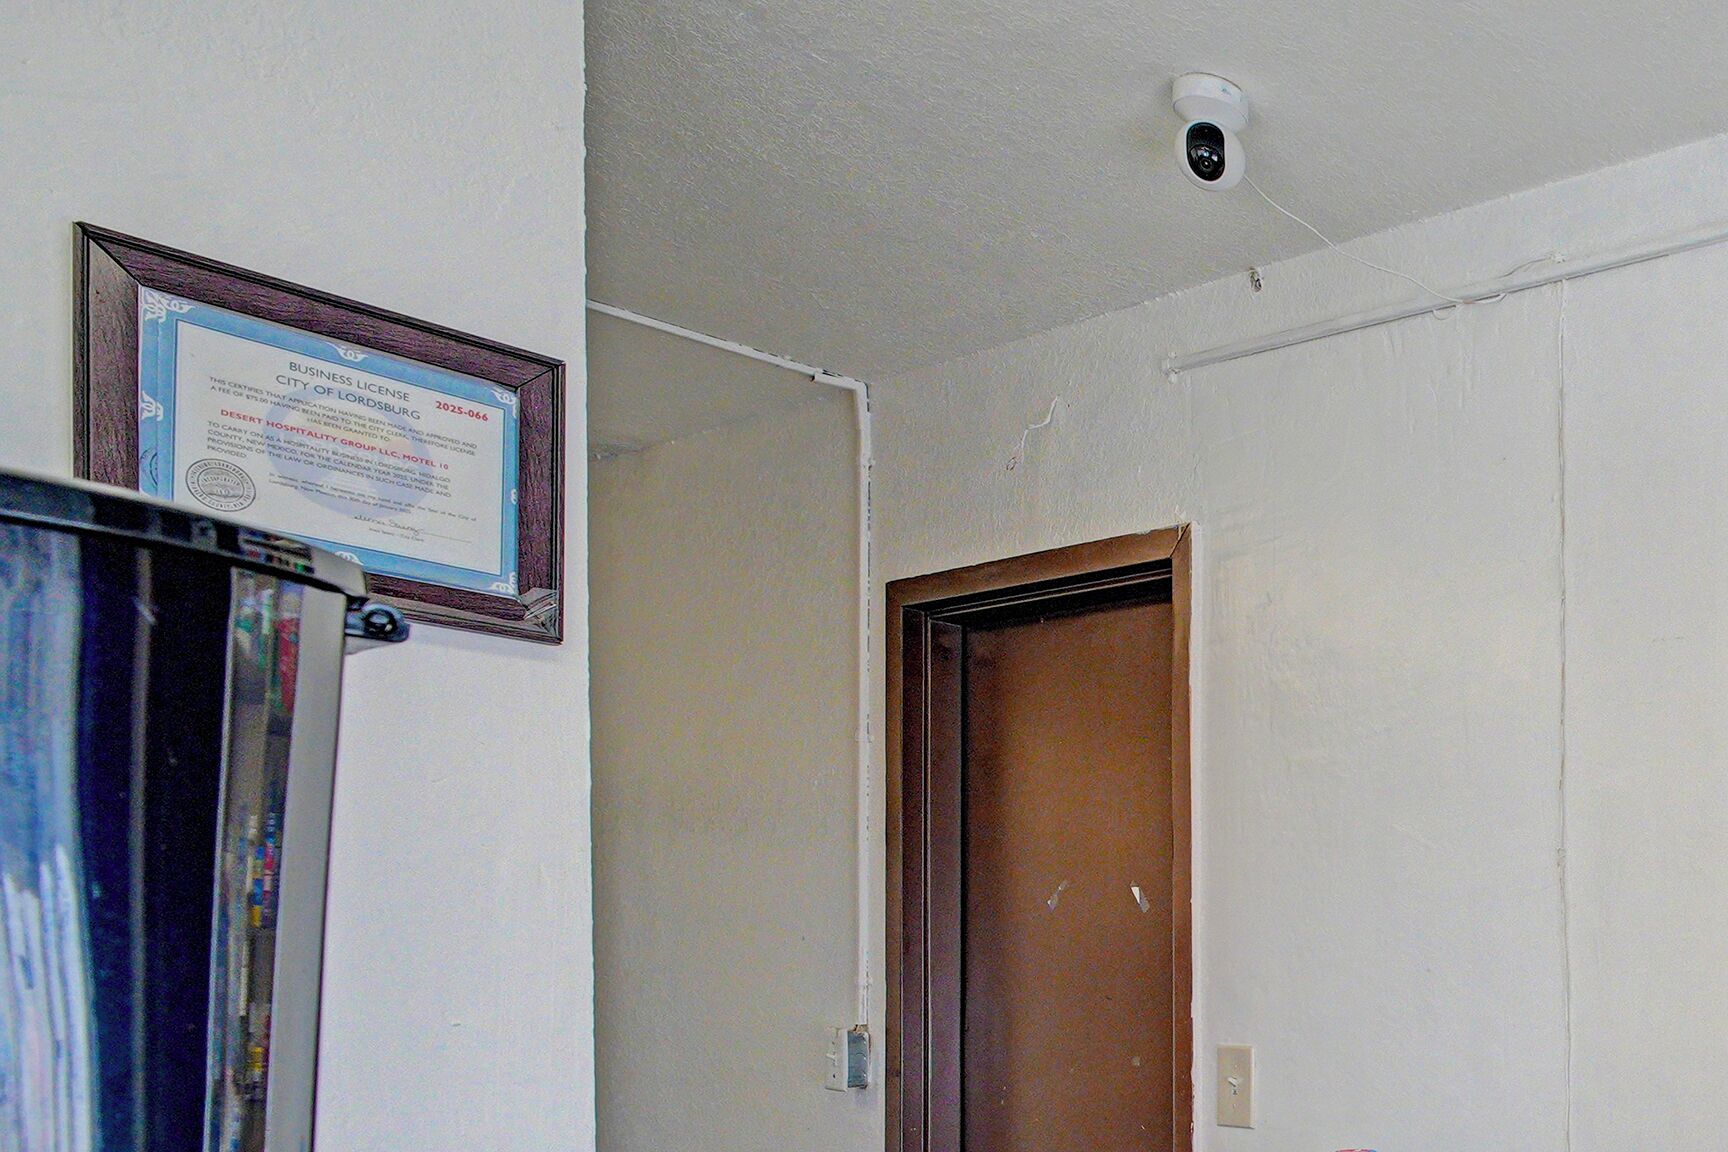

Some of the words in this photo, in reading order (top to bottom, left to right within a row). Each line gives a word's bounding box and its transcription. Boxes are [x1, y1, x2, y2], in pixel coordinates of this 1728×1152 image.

[275, 374, 310, 391] CITY
[313, 384, 334, 397] OF
[338, 390, 421, 421] LORDSBURG
[289, 361, 353, 386] BUSINESS
[356, 379, 410, 402] LICENSE
[209, 376, 226, 386] THIS
[227, 379, 263, 395] CERTIFIES
[265, 390, 286, 400] THAT
[288, 397, 337, 414] APPLICATION
[338, 408, 366, 421] HAVING
[368, 417, 386, 426] BEEN
[408, 427, 424, 436] AND
[425, 431, 460, 445] APPROVED
[462, 440, 478, 450] AND
[270, 400, 300, 412] HAVING
[354, 421, 367, 429] THE
[368, 424, 385, 434] CITY
[323, 421, 341, 430] BEEN
[342, 425, 378, 440] GRANTED
[435, 400, 489, 422] 2025-066
[220, 409, 263, 425] DESERT
[266, 420, 338, 443] HOSPITALITY
[340, 438, 377, 452] GROUP
[402, 453, 437, 468] MOTEL
[439, 462, 449, 470] 10
[221, 423, 248, 435] CARRY
[249, 430, 264, 438] ON
[283, 440, 331, 456] HOSPITALITY
[332, 450, 364, 463] BUSINESS
